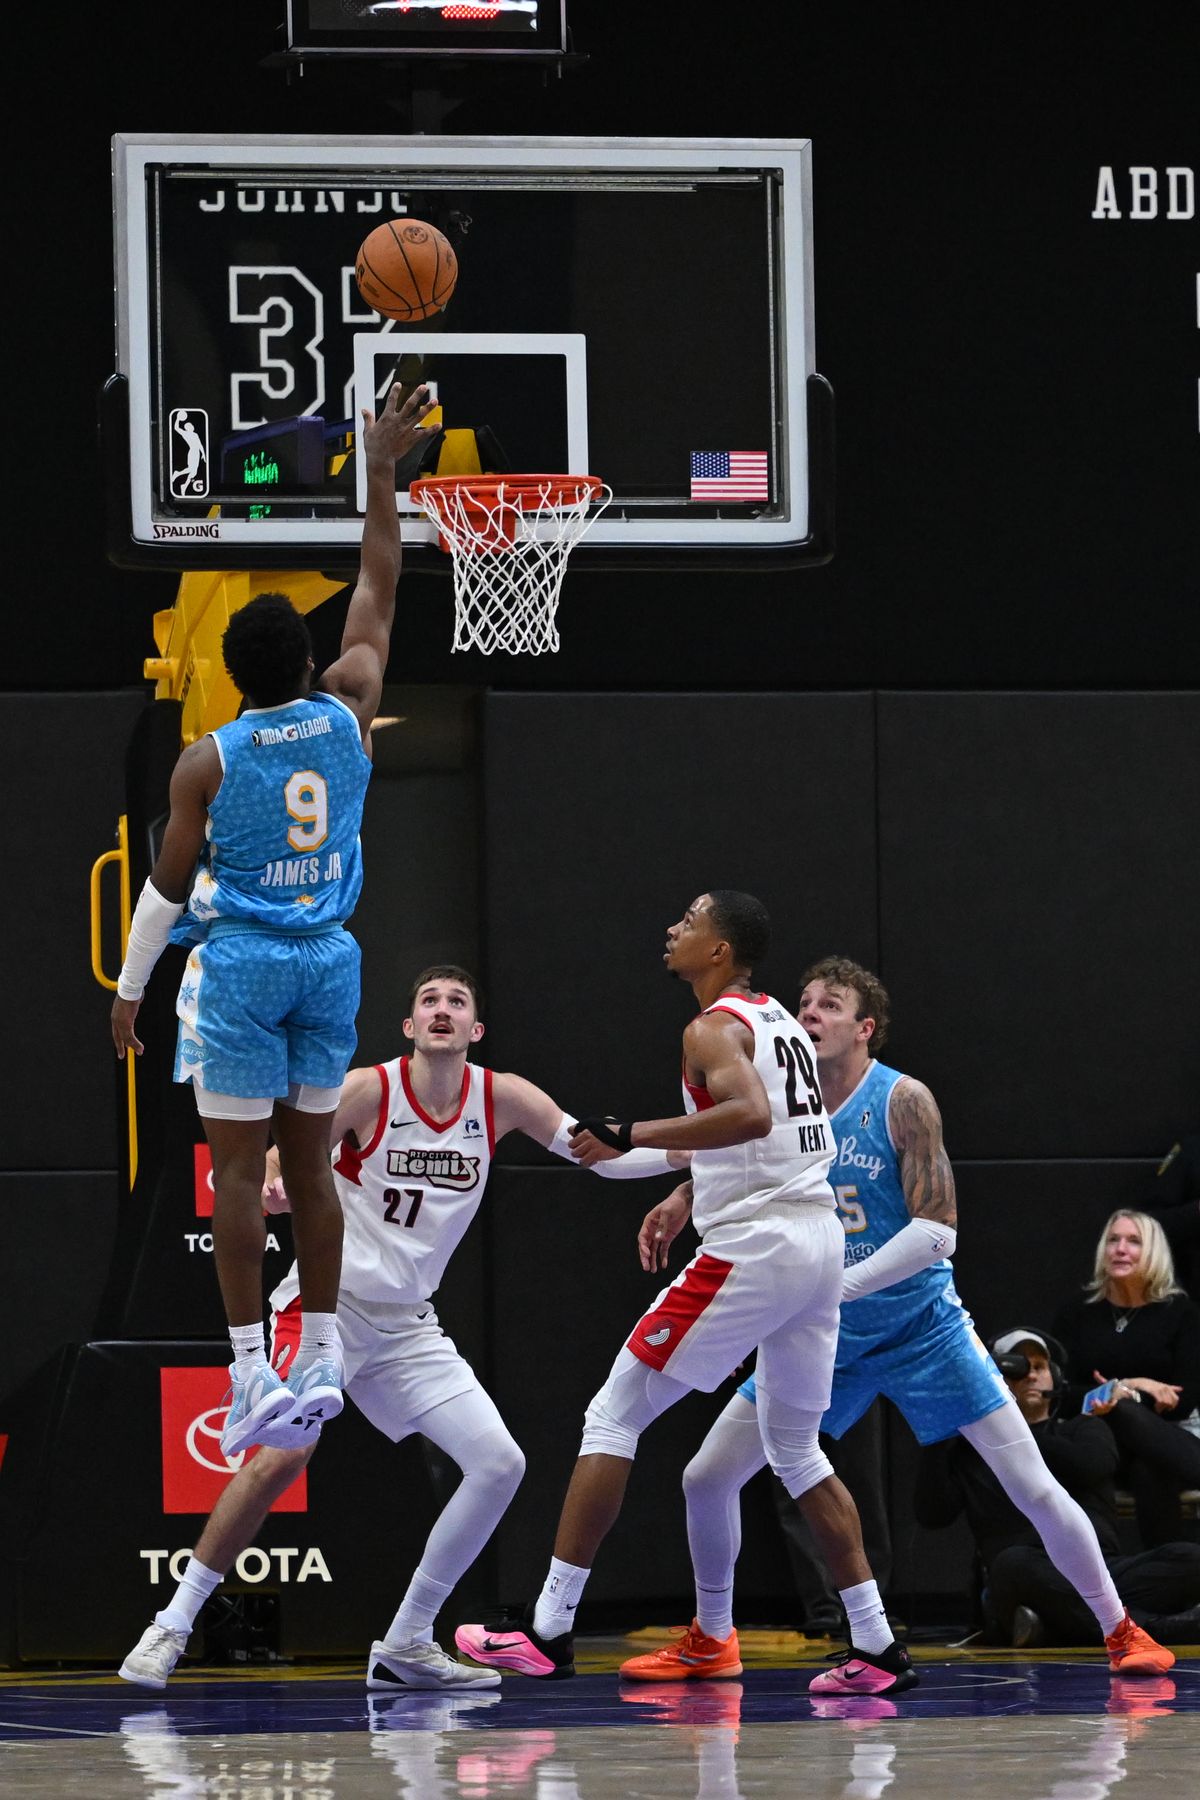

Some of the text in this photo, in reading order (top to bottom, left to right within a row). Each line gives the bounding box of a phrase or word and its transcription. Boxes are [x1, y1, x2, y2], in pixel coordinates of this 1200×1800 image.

[1092, 165, 1195, 220] ABD
[153, 524, 219, 539] SPALDING
[260, 726, 284, 746] NBA
[296, 715, 333, 740] LEAGUE
[284, 769, 329, 852] 9
[259, 852, 343, 888] JAMES JR
[773, 1035, 823, 1128] 29
[428, 1151, 451, 1160] CITY
[797, 1123, 827, 1154] KENT
[839, 1136, 886, 1180] Bay
[387, 1150, 480, 1191] Remix
[383, 1187, 424, 1229] 27
[183, 1232, 282, 1253] TOA
[138, 1546, 333, 1585] TOOTA
